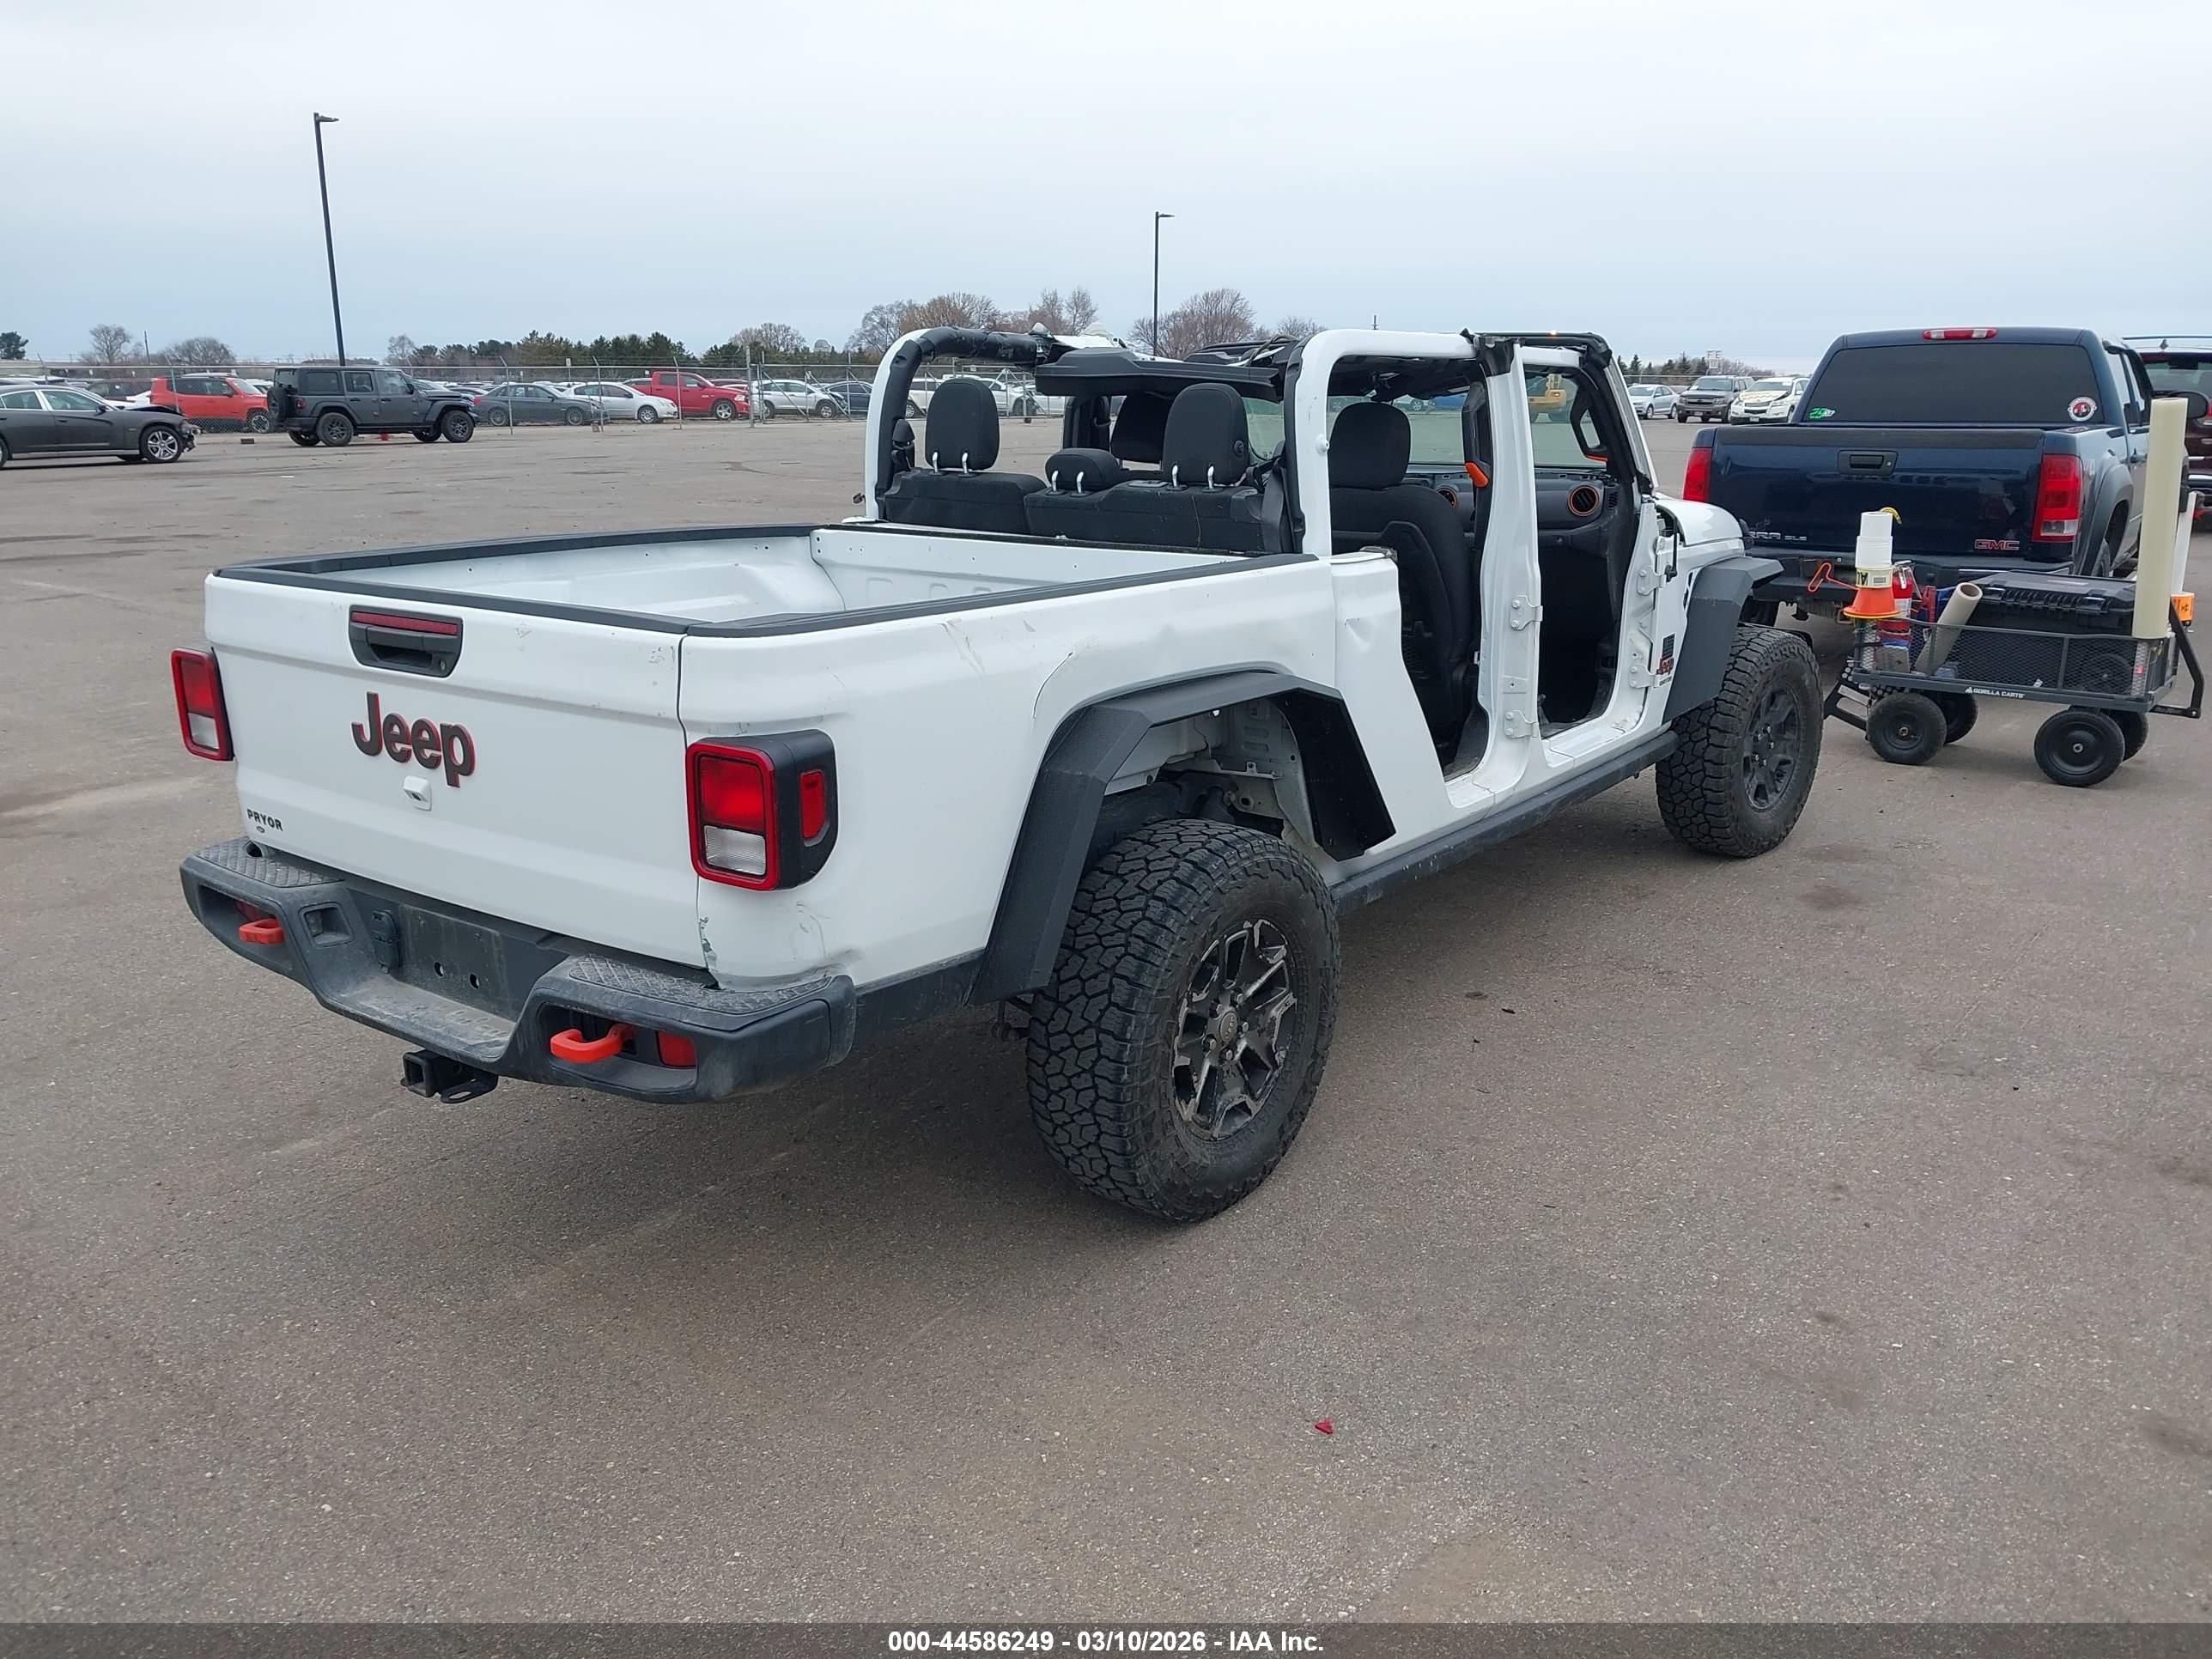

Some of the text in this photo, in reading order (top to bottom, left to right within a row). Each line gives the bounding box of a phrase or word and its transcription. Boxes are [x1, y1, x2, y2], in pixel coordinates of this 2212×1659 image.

[1974, 538, 2020, 550] GMC
[1973, 688, 2000, 696] GORILLA
[351, 691, 476, 788] Jeep
[246, 808, 283, 832] PRYOR
